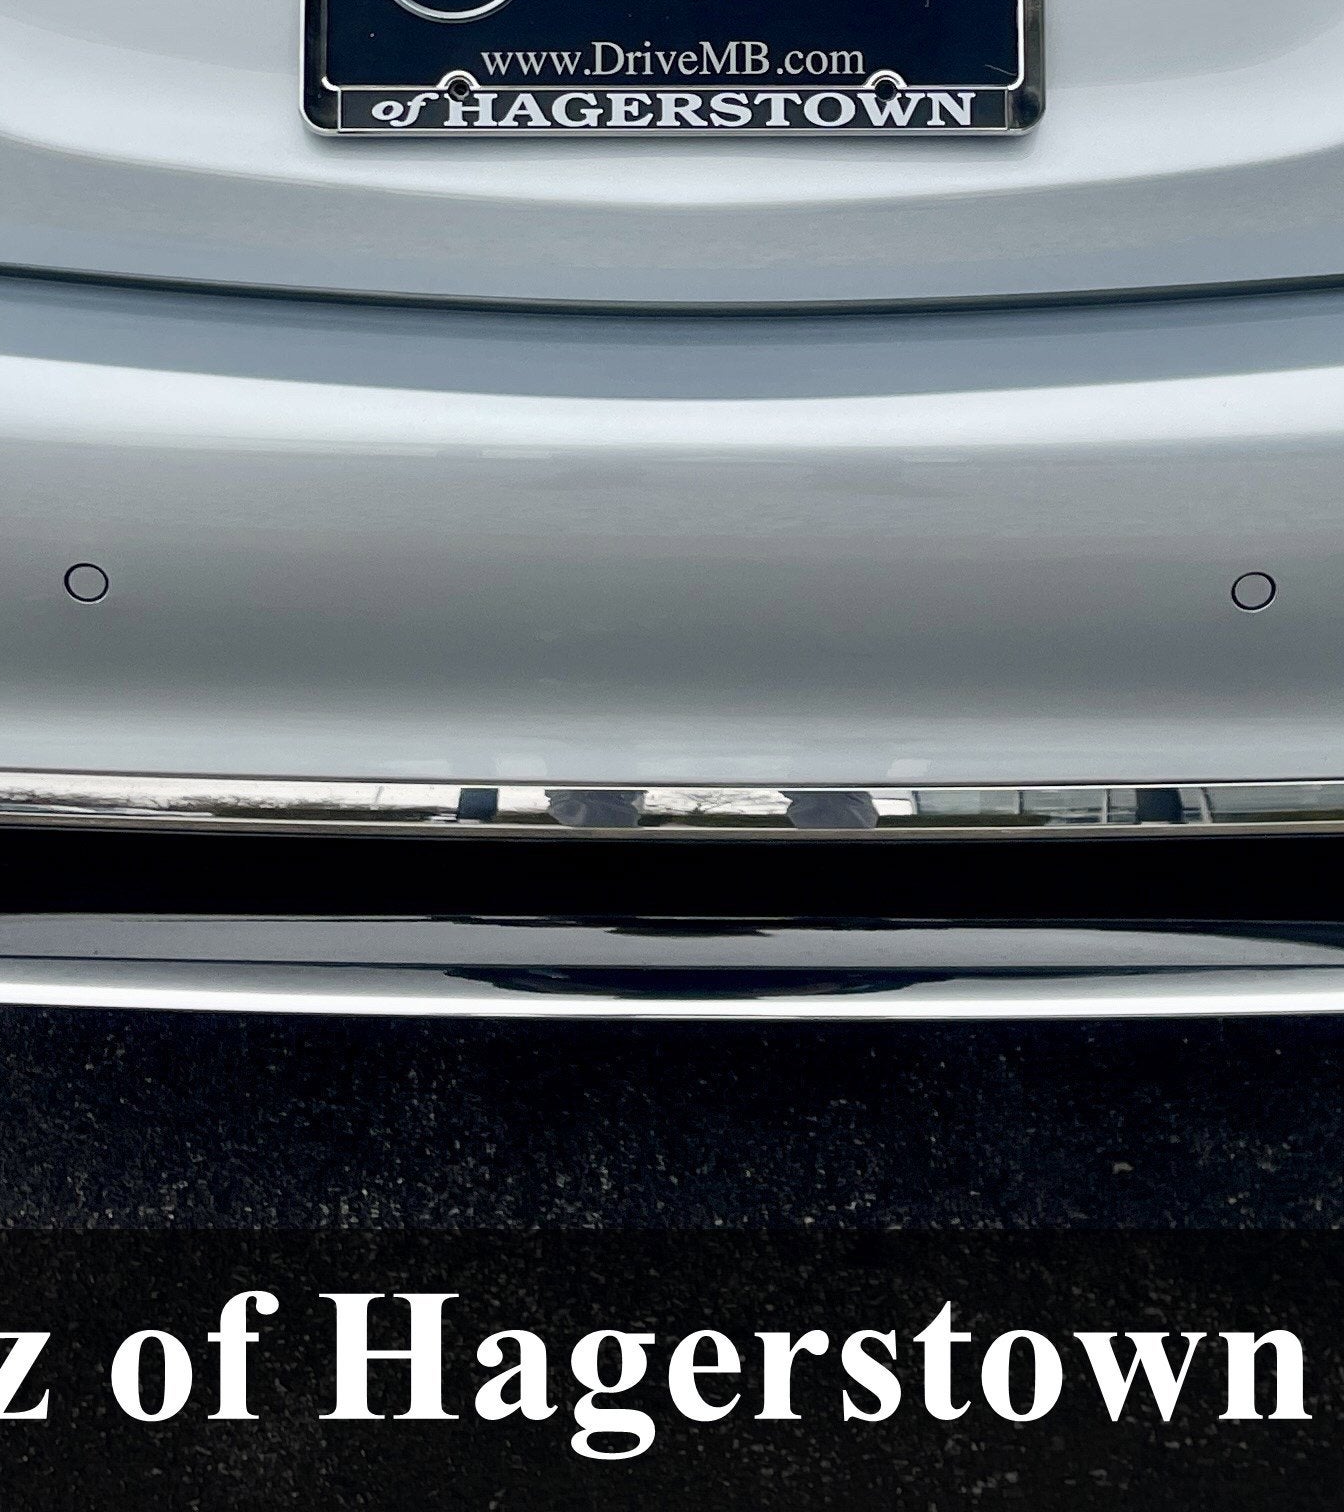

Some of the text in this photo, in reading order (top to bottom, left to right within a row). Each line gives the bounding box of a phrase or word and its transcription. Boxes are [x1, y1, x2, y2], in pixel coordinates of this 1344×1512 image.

[480, 40, 866, 77] www.DriveMB.com
[371, 92, 976, 128] of HAGERSTOWN
